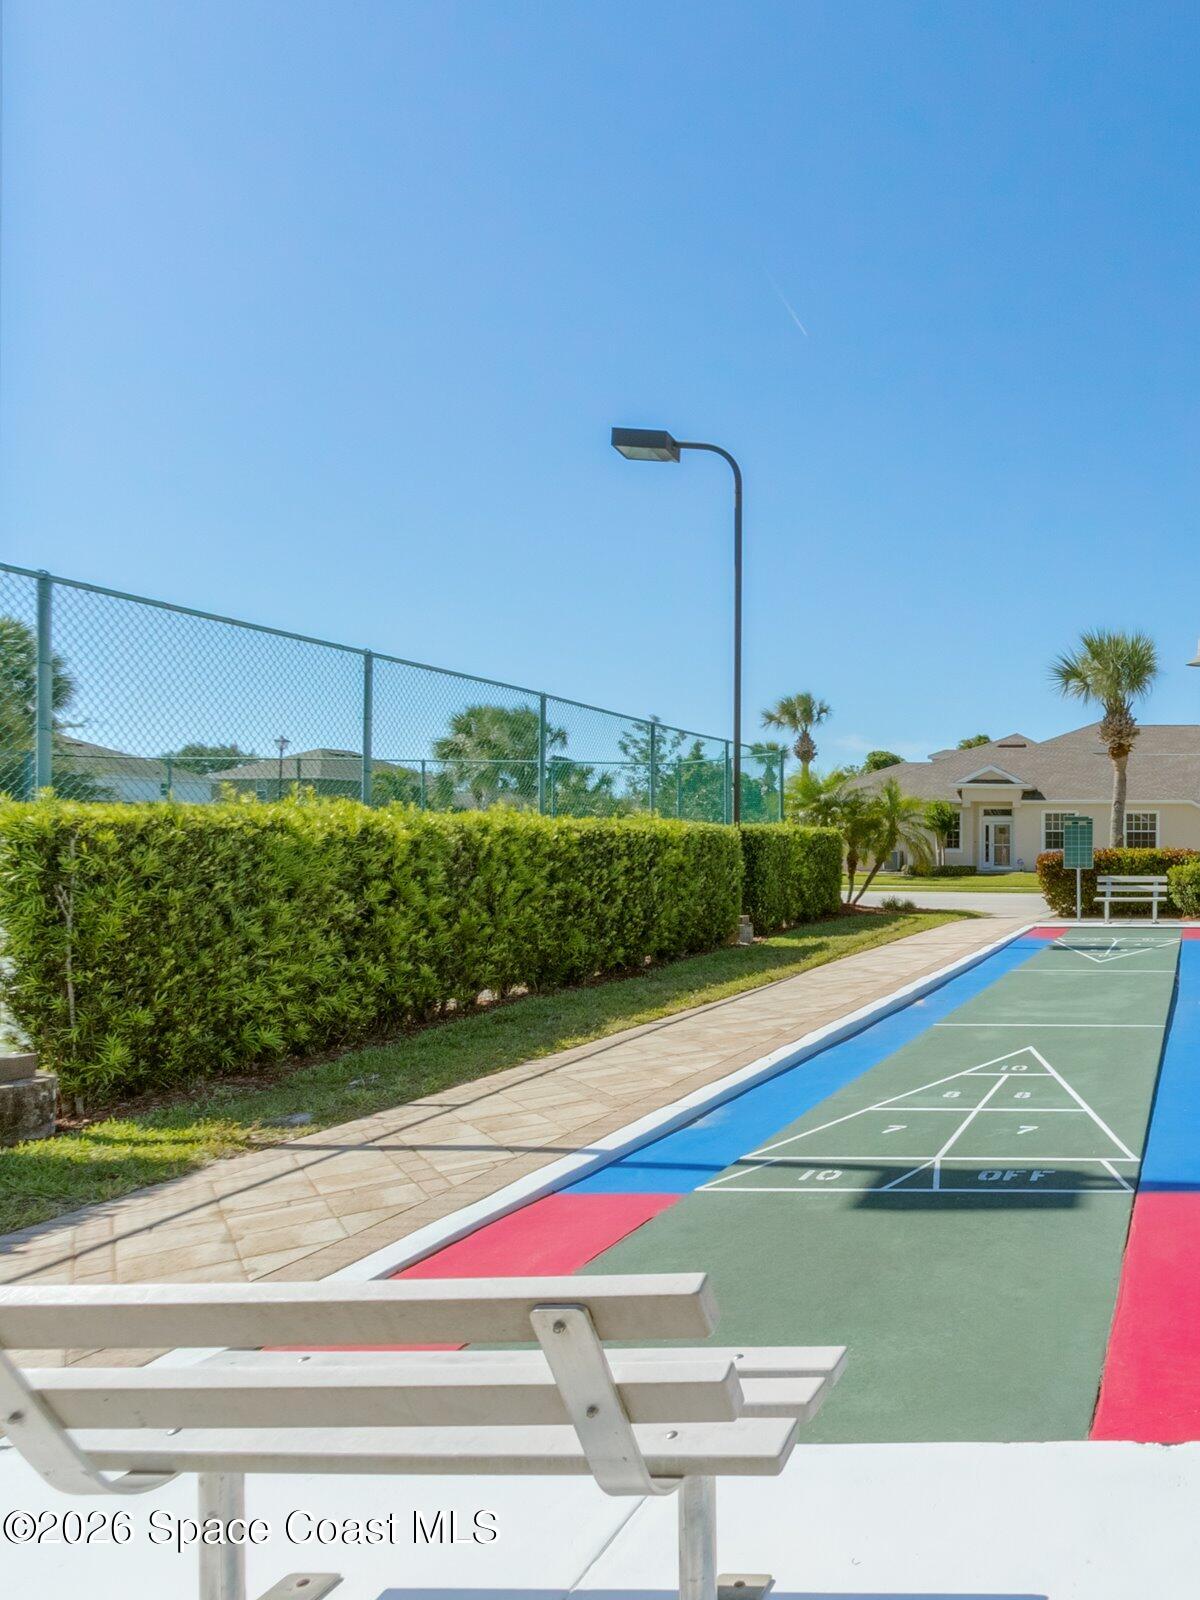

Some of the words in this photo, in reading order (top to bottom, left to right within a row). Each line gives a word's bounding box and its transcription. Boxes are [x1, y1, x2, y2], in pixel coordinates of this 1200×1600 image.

[881, 1124, 908, 1134] 7
[1016, 1125, 1039, 1135] 7
[798, 1169, 844, 1182] 10
[976, 1169, 1057, 1182] OFF
